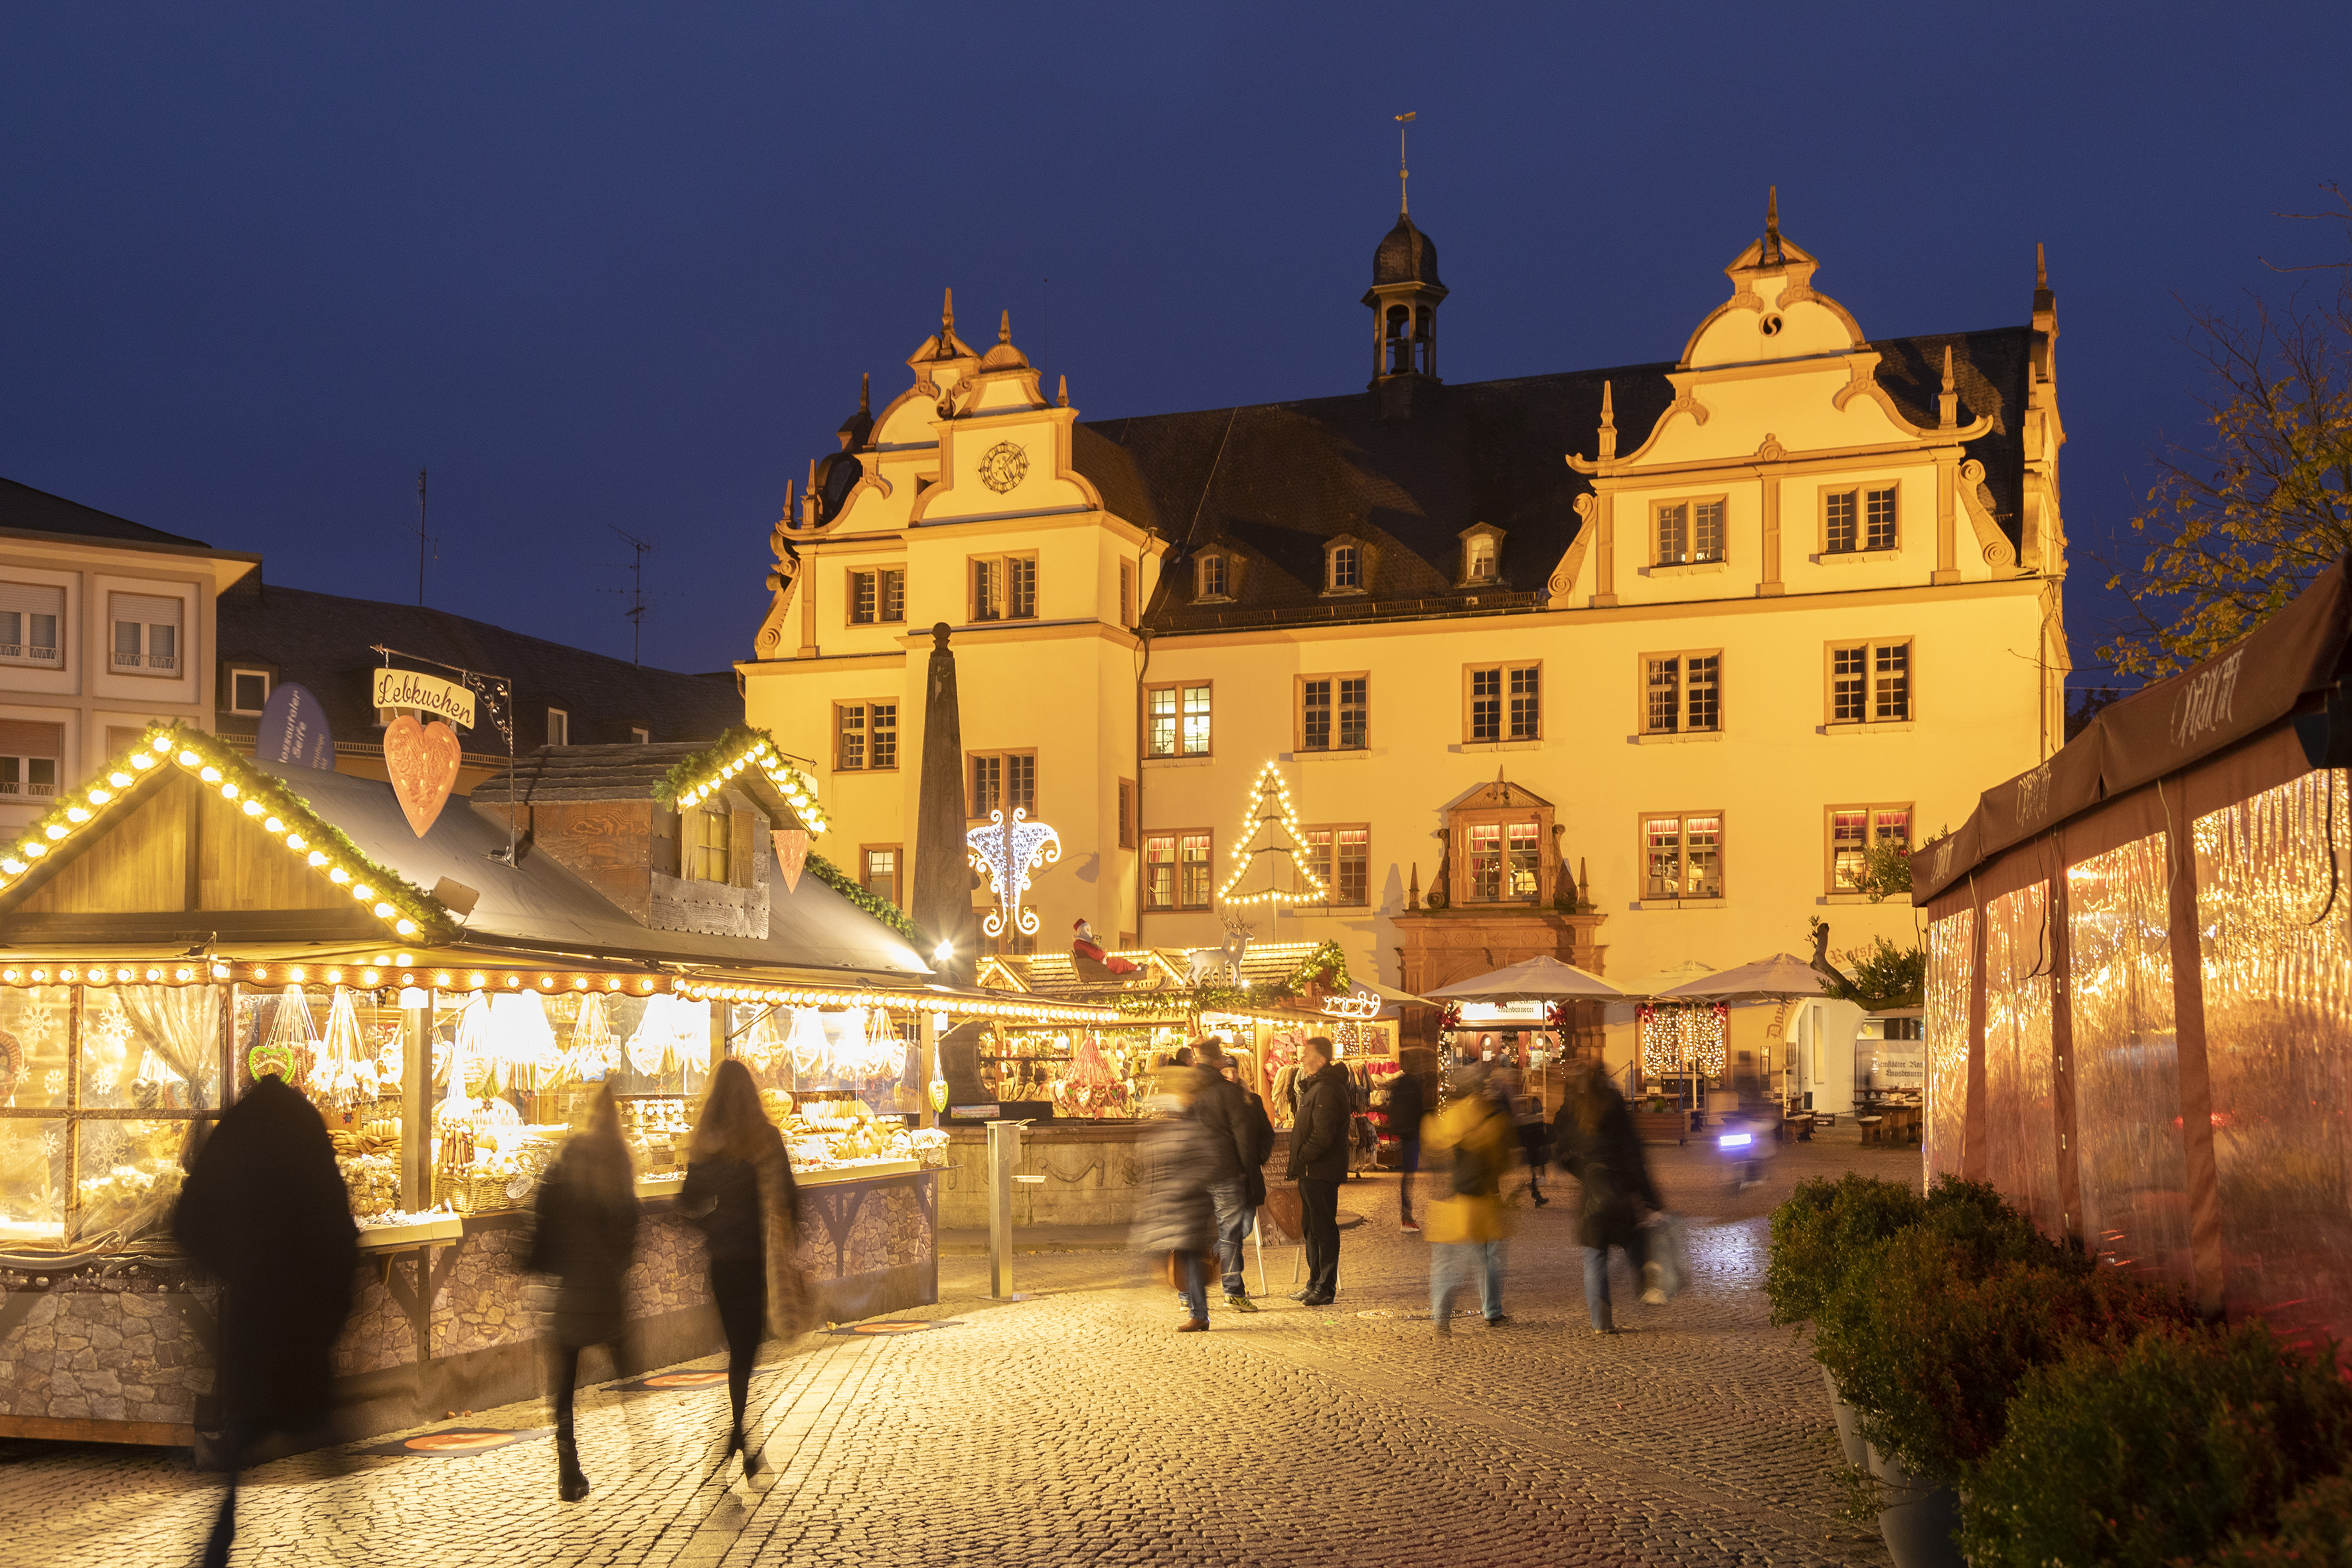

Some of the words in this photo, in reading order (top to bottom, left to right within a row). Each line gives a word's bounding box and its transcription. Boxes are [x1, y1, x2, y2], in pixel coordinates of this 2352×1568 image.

[377, 674, 473, 724] Lebkuchen
[277, 690, 301, 763] ossautaler
[292, 722, 307, 759] Seife
[1885, 1069, 1923, 1077] Hausbrauere
[1260, 1164, 1289, 1174] Lebku
